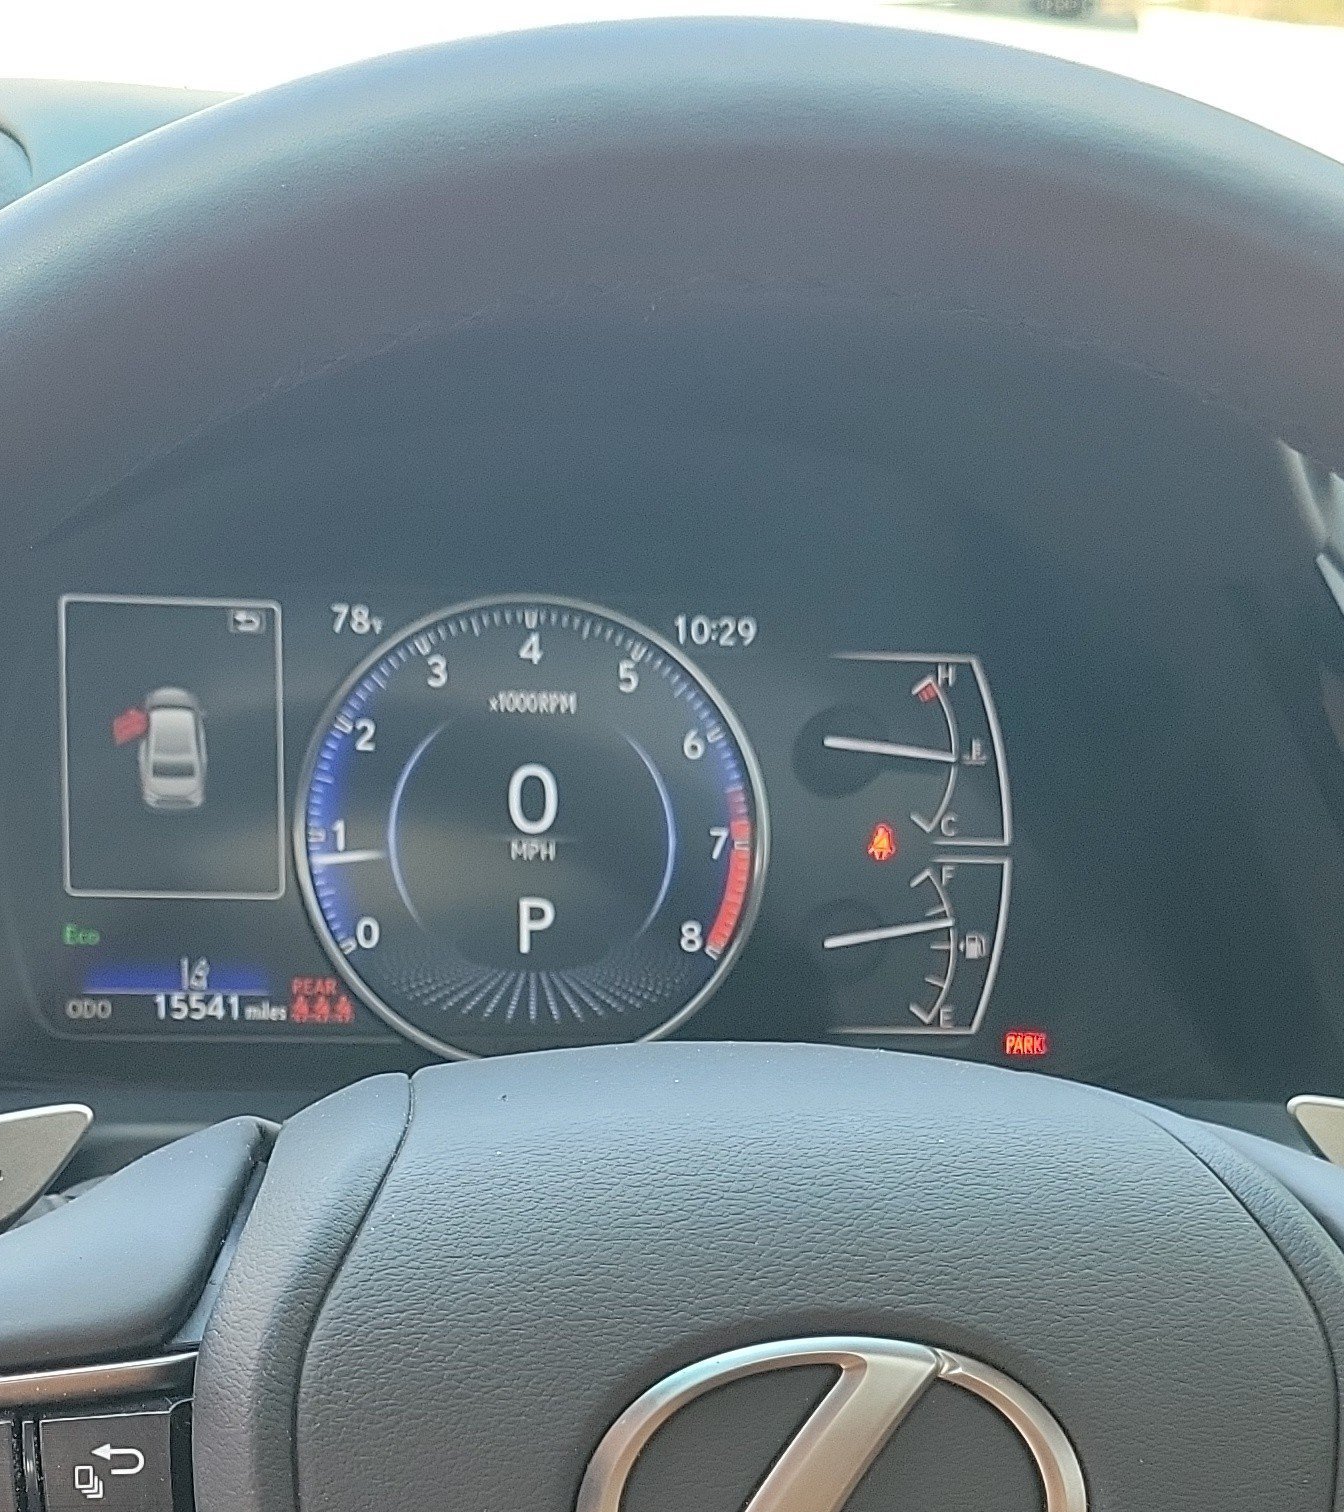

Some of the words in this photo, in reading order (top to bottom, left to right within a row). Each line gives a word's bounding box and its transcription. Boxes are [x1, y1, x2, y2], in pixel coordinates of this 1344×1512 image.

[674, 614, 757, 646] 10:29
[519, 631, 543, 665] 4
[426, 654, 448, 687] 3
[619, 661, 639, 693] 5
[937, 663, 954, 687] H
[356, 718, 376, 752] 2
[684, 729, 705, 760] 6
[508, 763, 558, 835] 0
[332, 819, 345, 851] 1
[940, 817, 956, 837] C
[510, 839, 557, 861] MPH
[709, 827, 729, 860] 7
[942, 865, 956, 886] F
[62, 923, 100, 945] Eco
[356, 916, 380, 949] 0
[519, 897, 555, 954] P
[680, 919, 703, 953] 8
[65, 1000, 112, 1019] ODO
[155, 994, 240, 1021] 15541
[244, 1002, 287, 1022] miles
[940, 1006, 955, 1029] E
[1005, 1033, 1046, 1055] PARK
